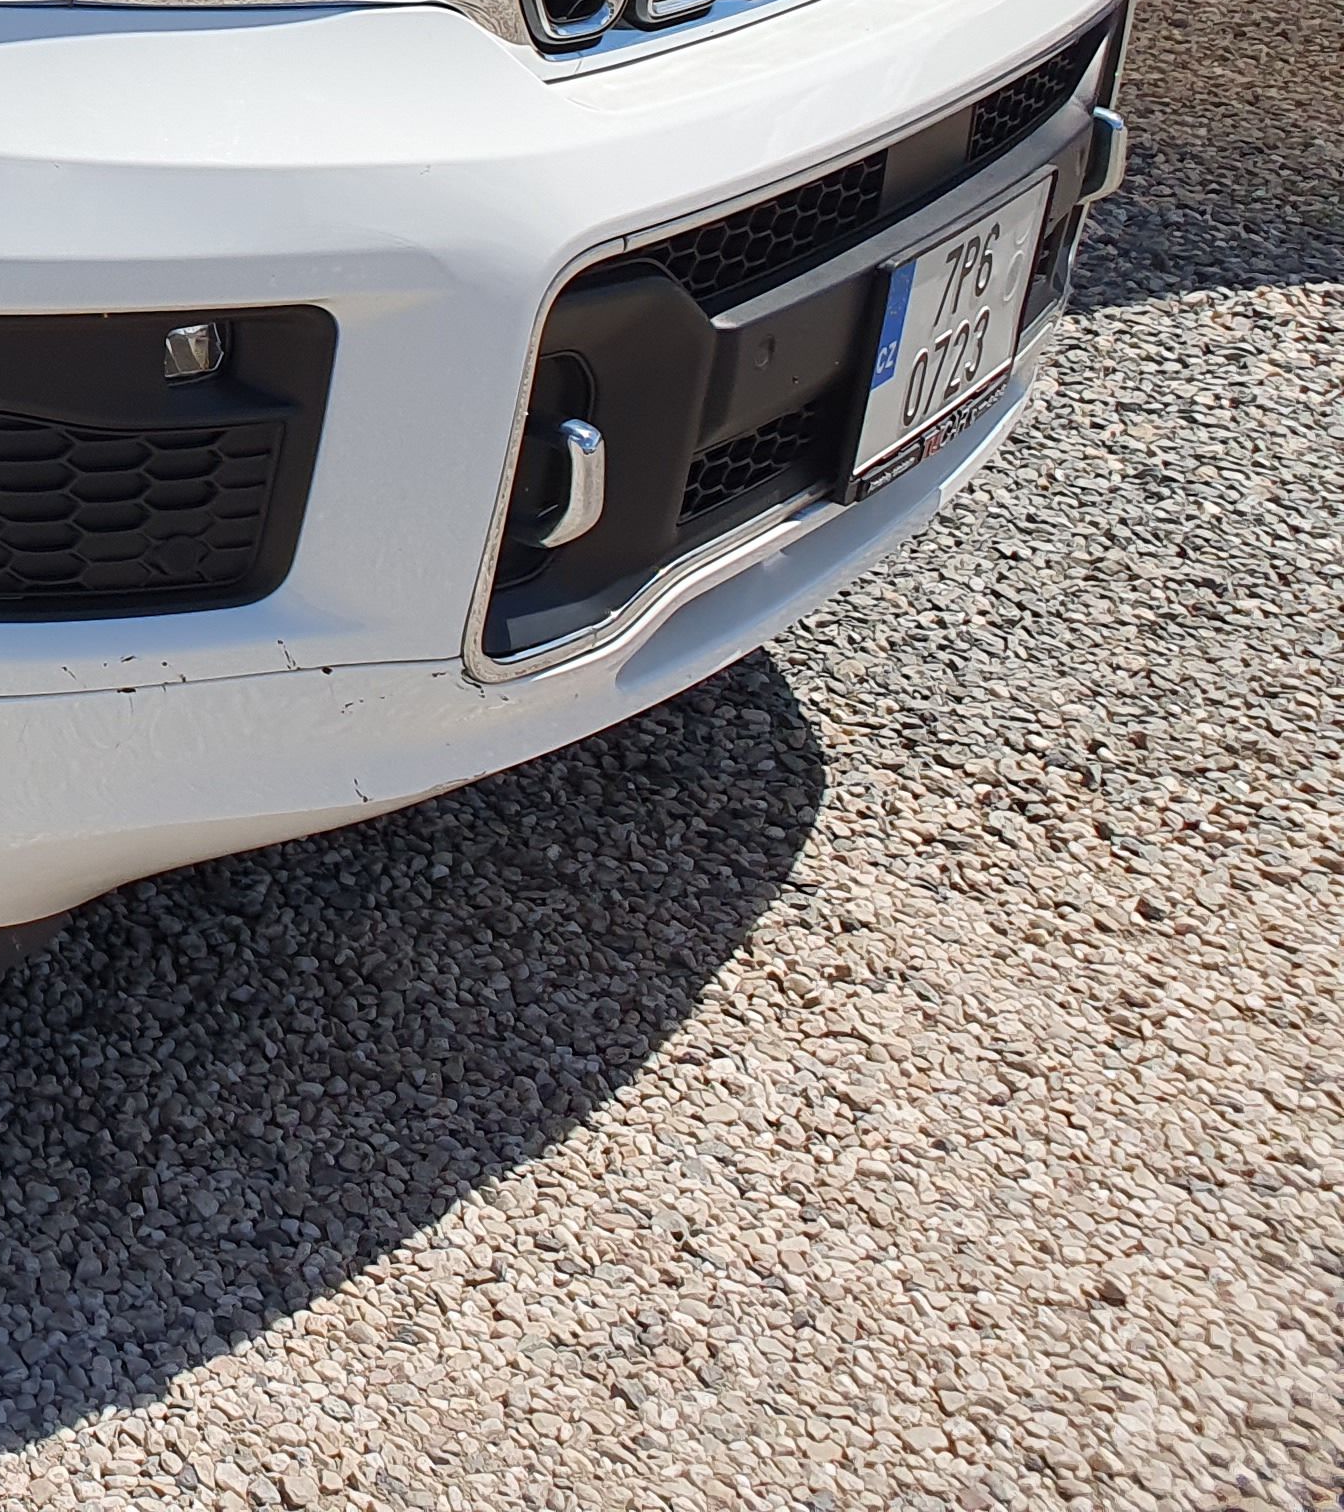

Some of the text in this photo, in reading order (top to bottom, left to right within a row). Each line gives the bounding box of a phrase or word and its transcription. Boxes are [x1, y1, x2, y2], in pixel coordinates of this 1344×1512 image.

[932, 222, 1001, 328] 7P6
[873, 339, 898, 376] CZ
[901, 304, 991, 428] 0723
